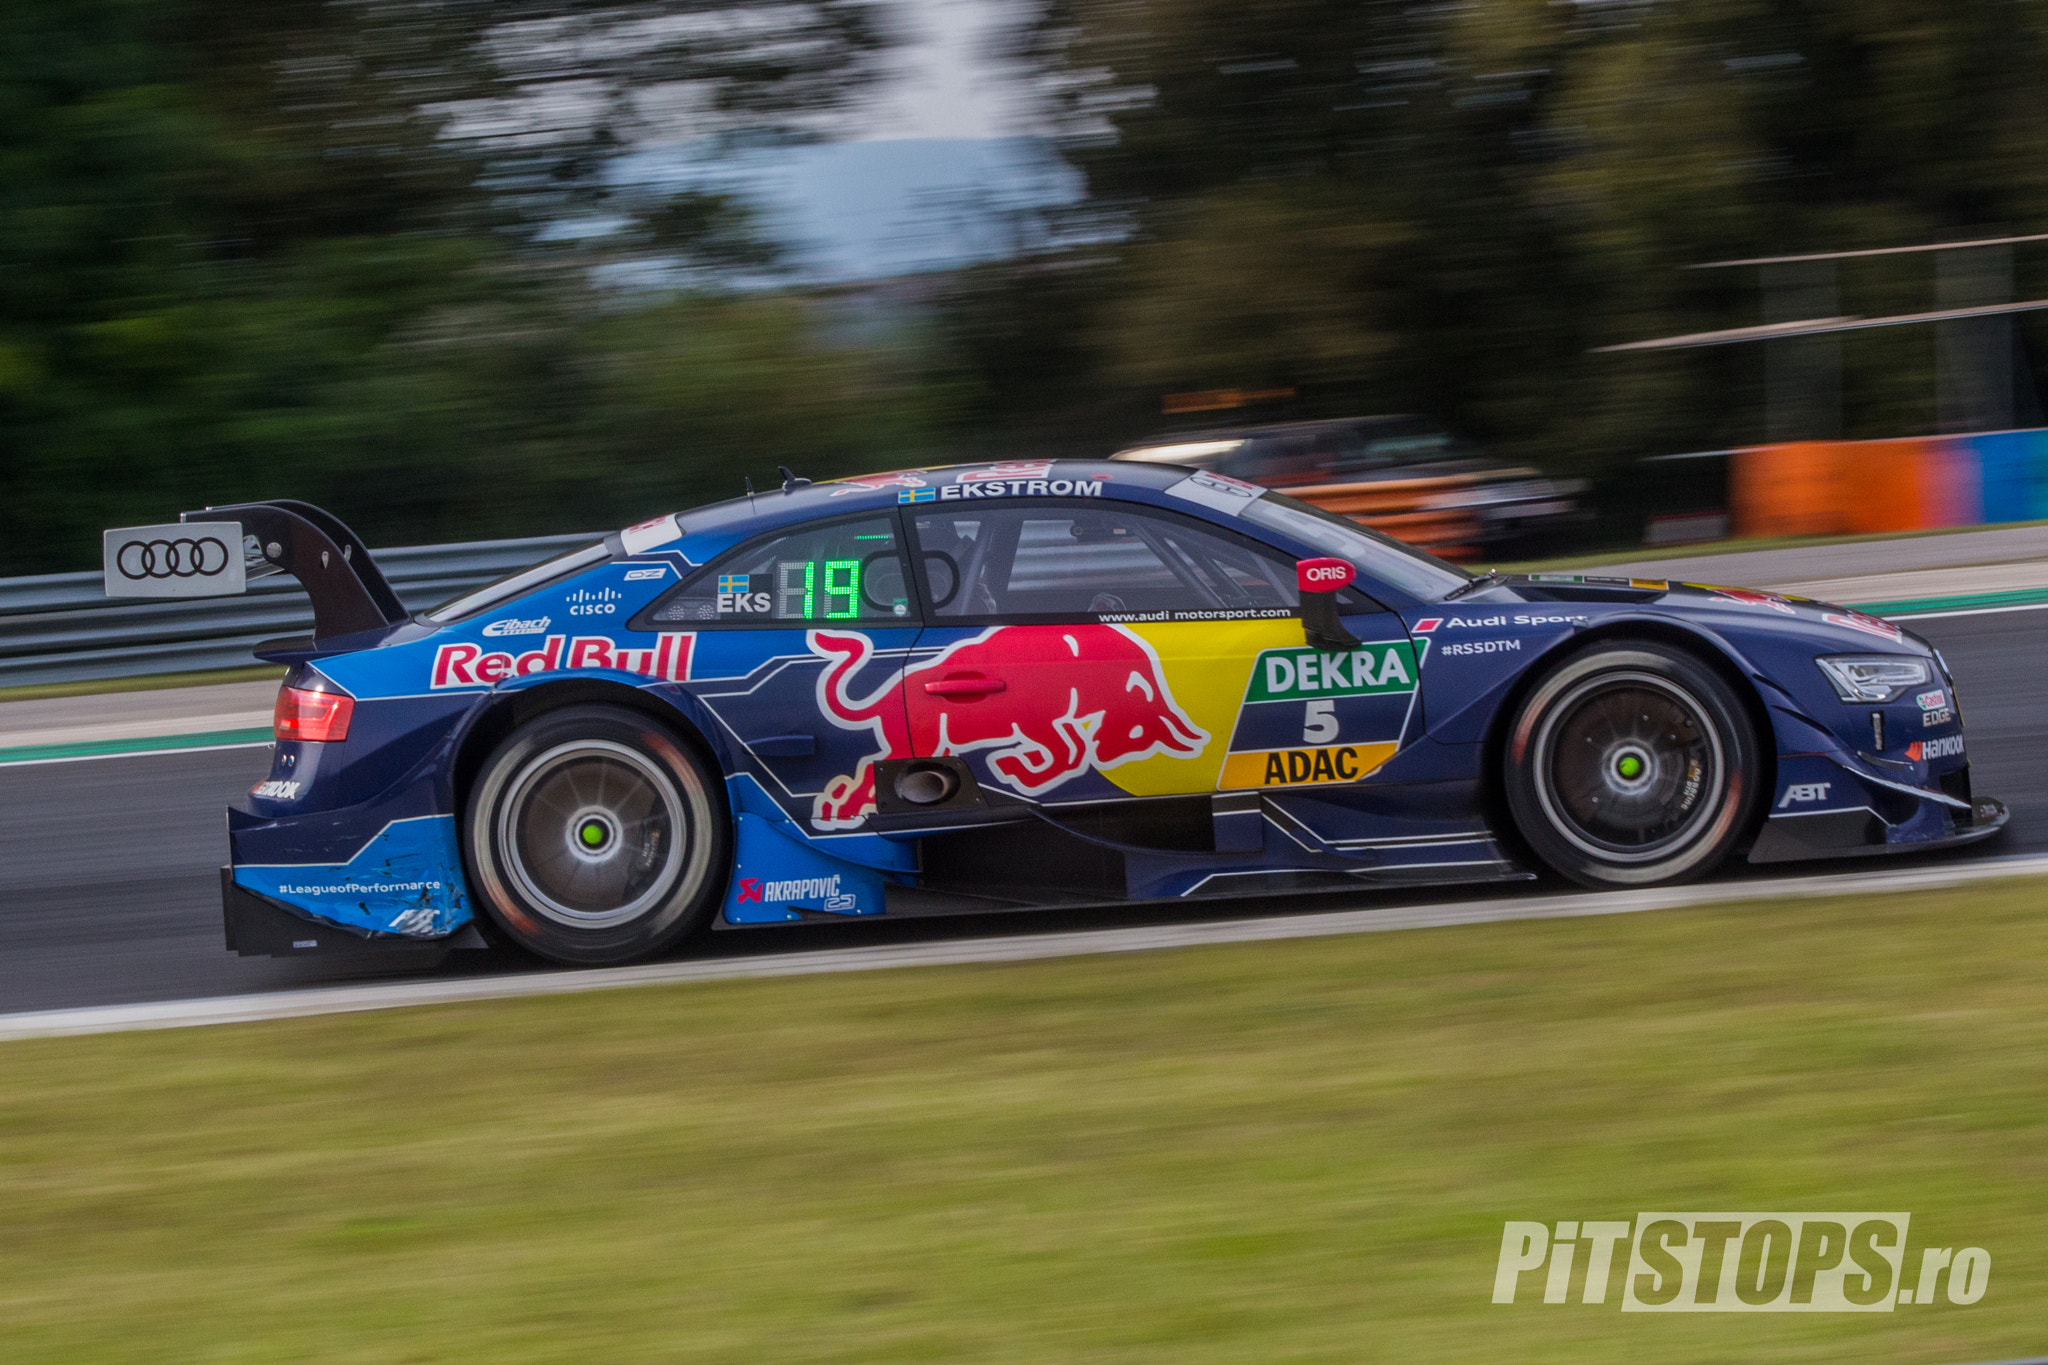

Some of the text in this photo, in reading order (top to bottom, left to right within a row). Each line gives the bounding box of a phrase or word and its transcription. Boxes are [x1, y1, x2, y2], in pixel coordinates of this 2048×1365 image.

[941, 480, 1103, 500] EKSTROM
[1306, 567, 1346, 581] ORIS
[804, 560, 860, 619] 19
[717, 592, 771, 613] EKS
[1175, 608, 1290, 621] motorsport.com
[1446, 615, 1589, 628] Audi Sport
[482, 616, 551, 637] Eibach
[1441, 639, 1521, 656] #RS5DTM
[430, 632, 697, 689] Red Bull
[1265, 648, 1410, 693] DEKRA
[1303, 700, 1340, 744] 5
[1923, 707, 1951, 727] EDGE
[1264, 747, 1359, 785] ADAC
[1778, 782, 1831, 808] ABT
[279, 880, 441, 896] #LeagueofPerformance
